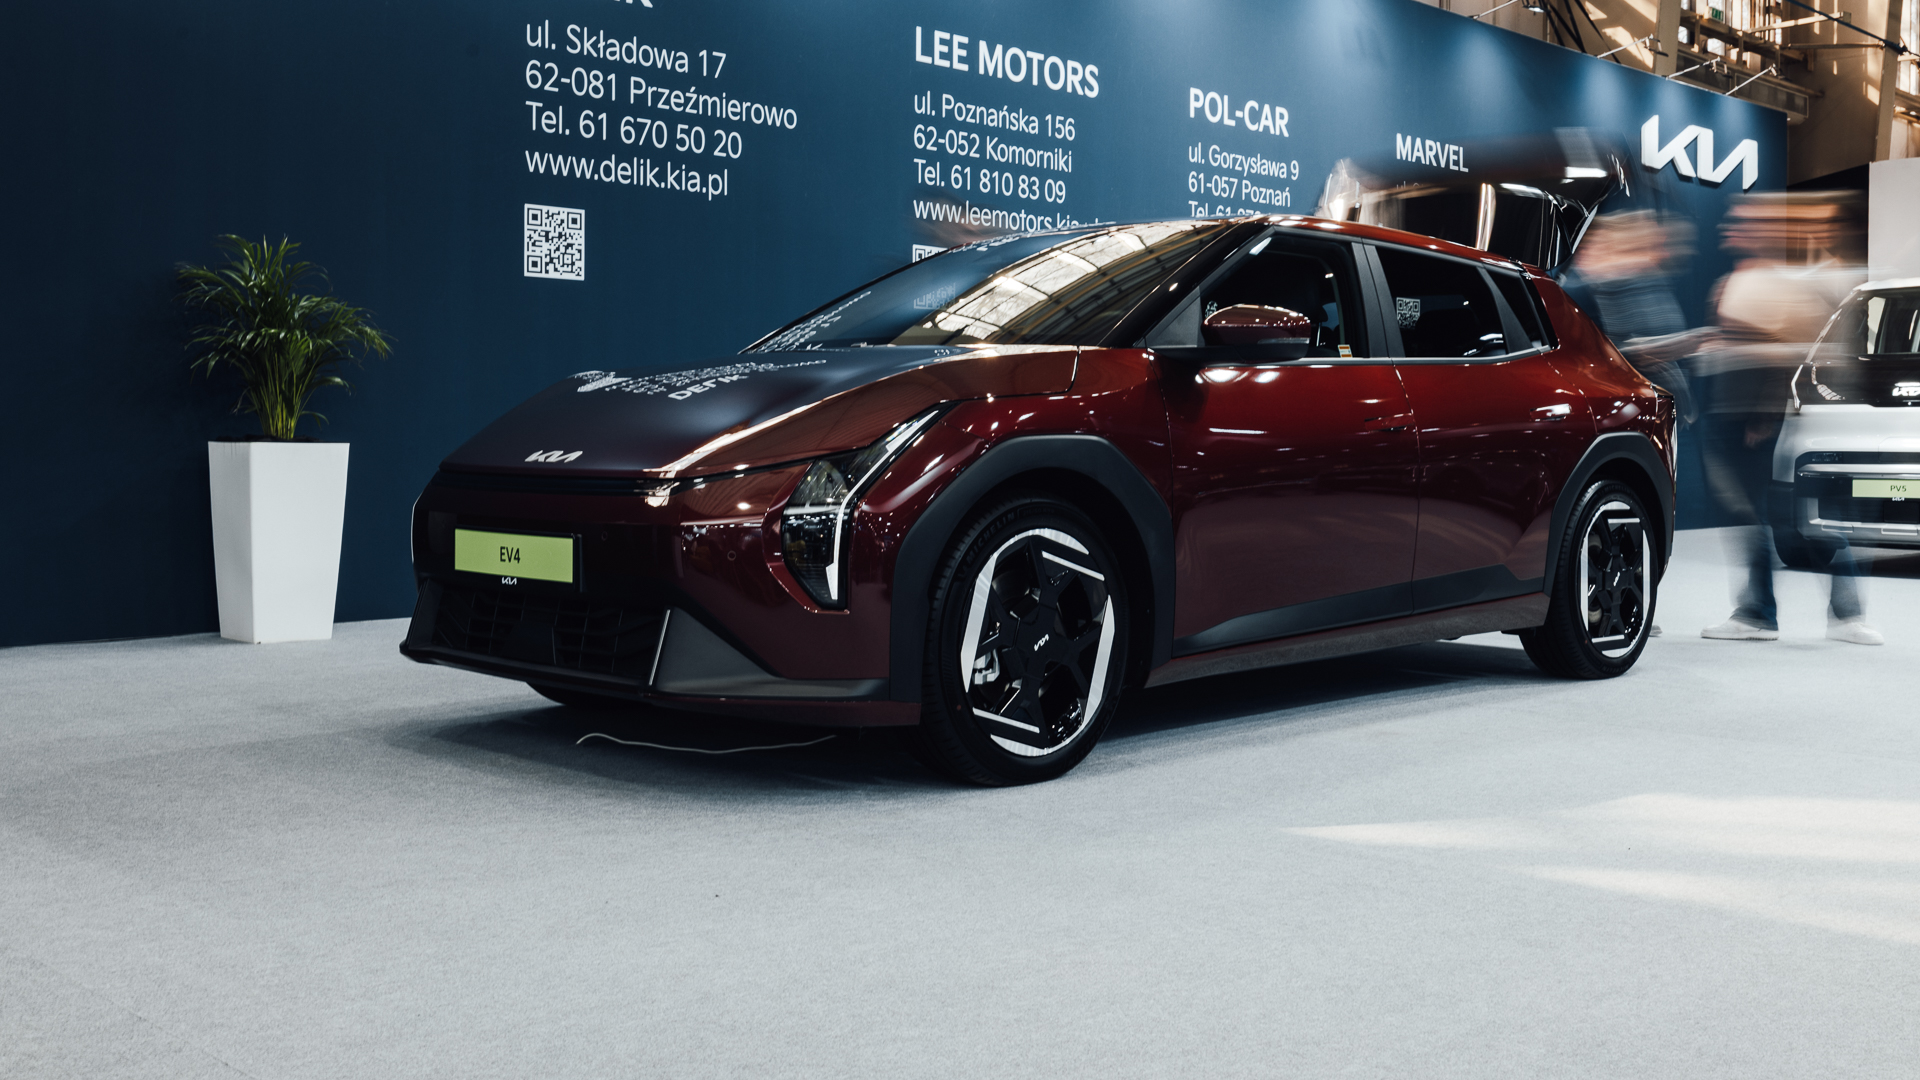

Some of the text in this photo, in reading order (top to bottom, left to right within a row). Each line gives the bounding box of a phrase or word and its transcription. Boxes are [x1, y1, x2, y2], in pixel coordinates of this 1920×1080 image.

[526, 20, 727, 78] ul. Składowa 17
[915, 26, 1100, 98] LEE MOTORS
[525, 60, 798, 129] 62-081 Przeźmierowo
[914, 91, 1076, 141] ul. Poznańska 156
[1190, 87, 1290, 137] POL-CAR
[525, 101, 743, 159] Tel. 61 670 50 20
[914, 124, 1072, 172] 62-052 Komorniki
[1396, 132, 1469, 173] MARVEL
[1641, 115, 1759, 190] KIA
[525, 150, 728, 201] www.delik.kia.pl
[914, 158, 1067, 204] Tel. 61 810 83 09
[1189, 142, 1300, 181] ul. Gorzysława 9
[1189, 171, 1291, 208] 61-057 Poznań
[524, 450, 583, 463] KIA
[500, 546, 521, 564] EV4
[966, 512, 1015, 565] MICHELIN
